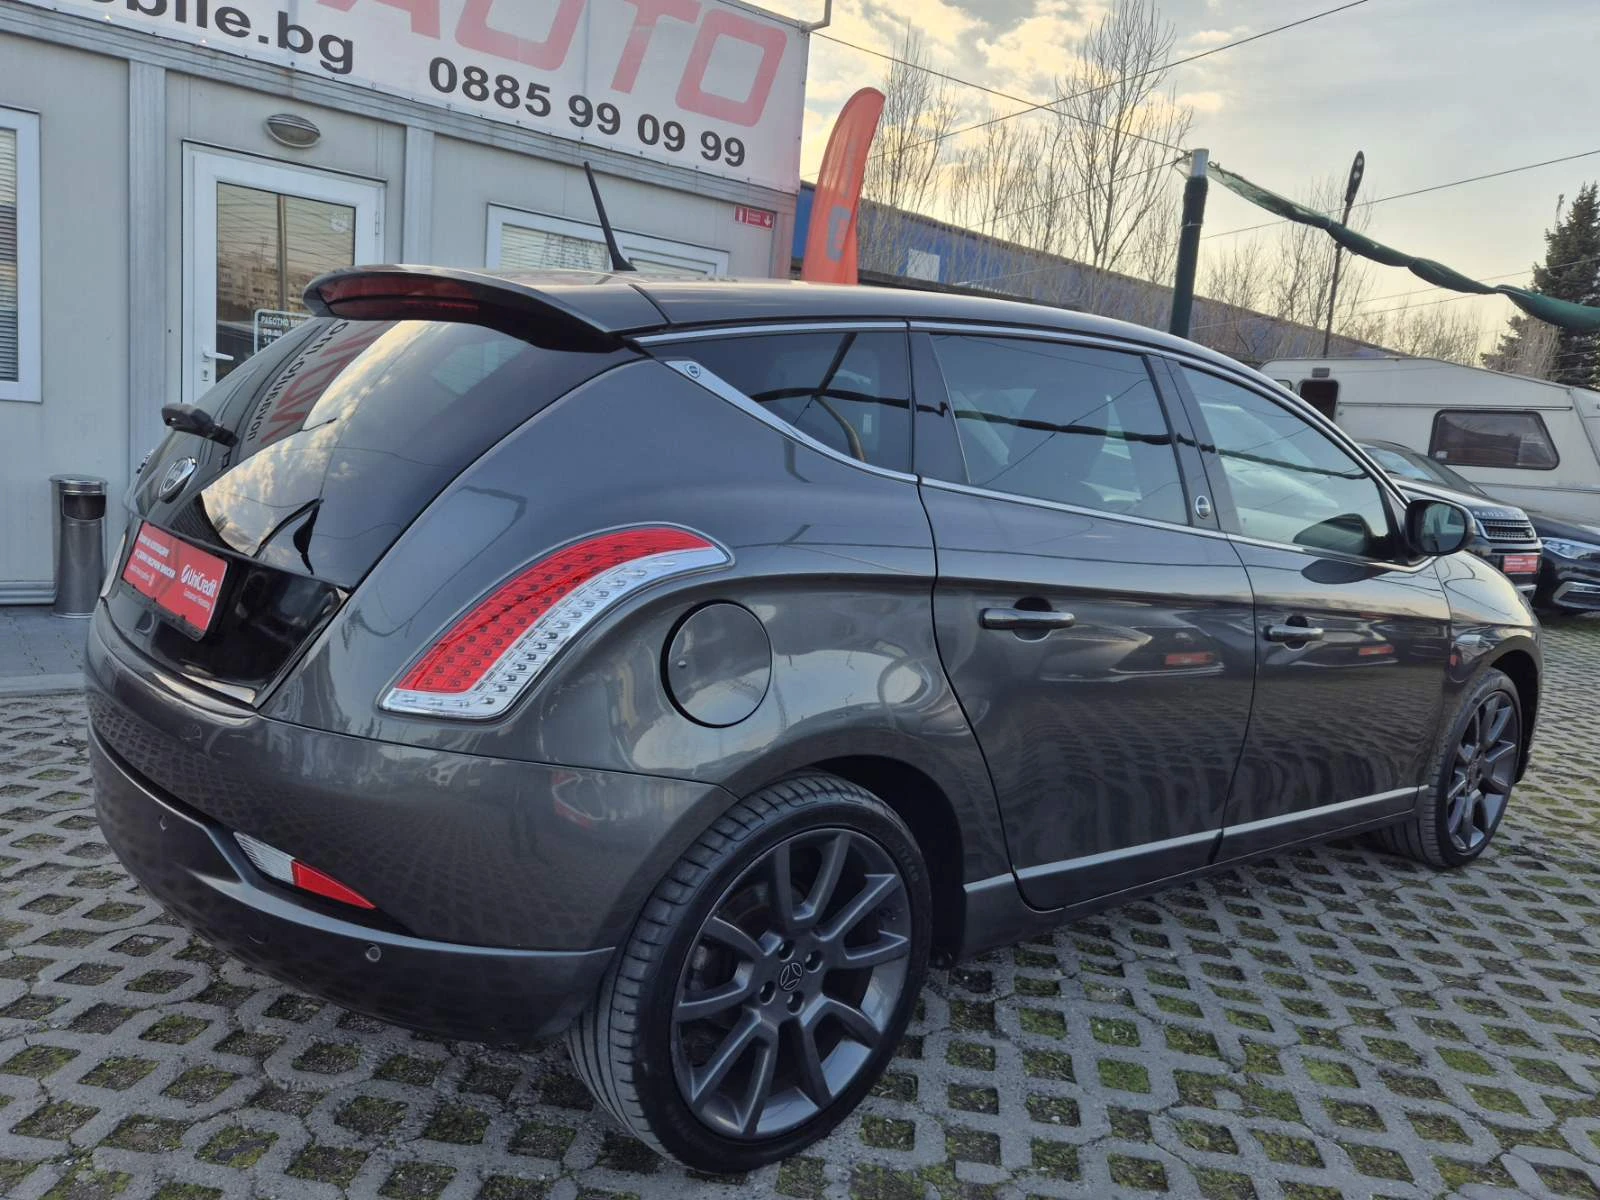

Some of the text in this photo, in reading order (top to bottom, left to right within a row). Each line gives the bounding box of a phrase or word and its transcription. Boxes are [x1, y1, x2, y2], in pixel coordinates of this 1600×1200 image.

[429, 56, 746, 168] 0885 99 09 99
